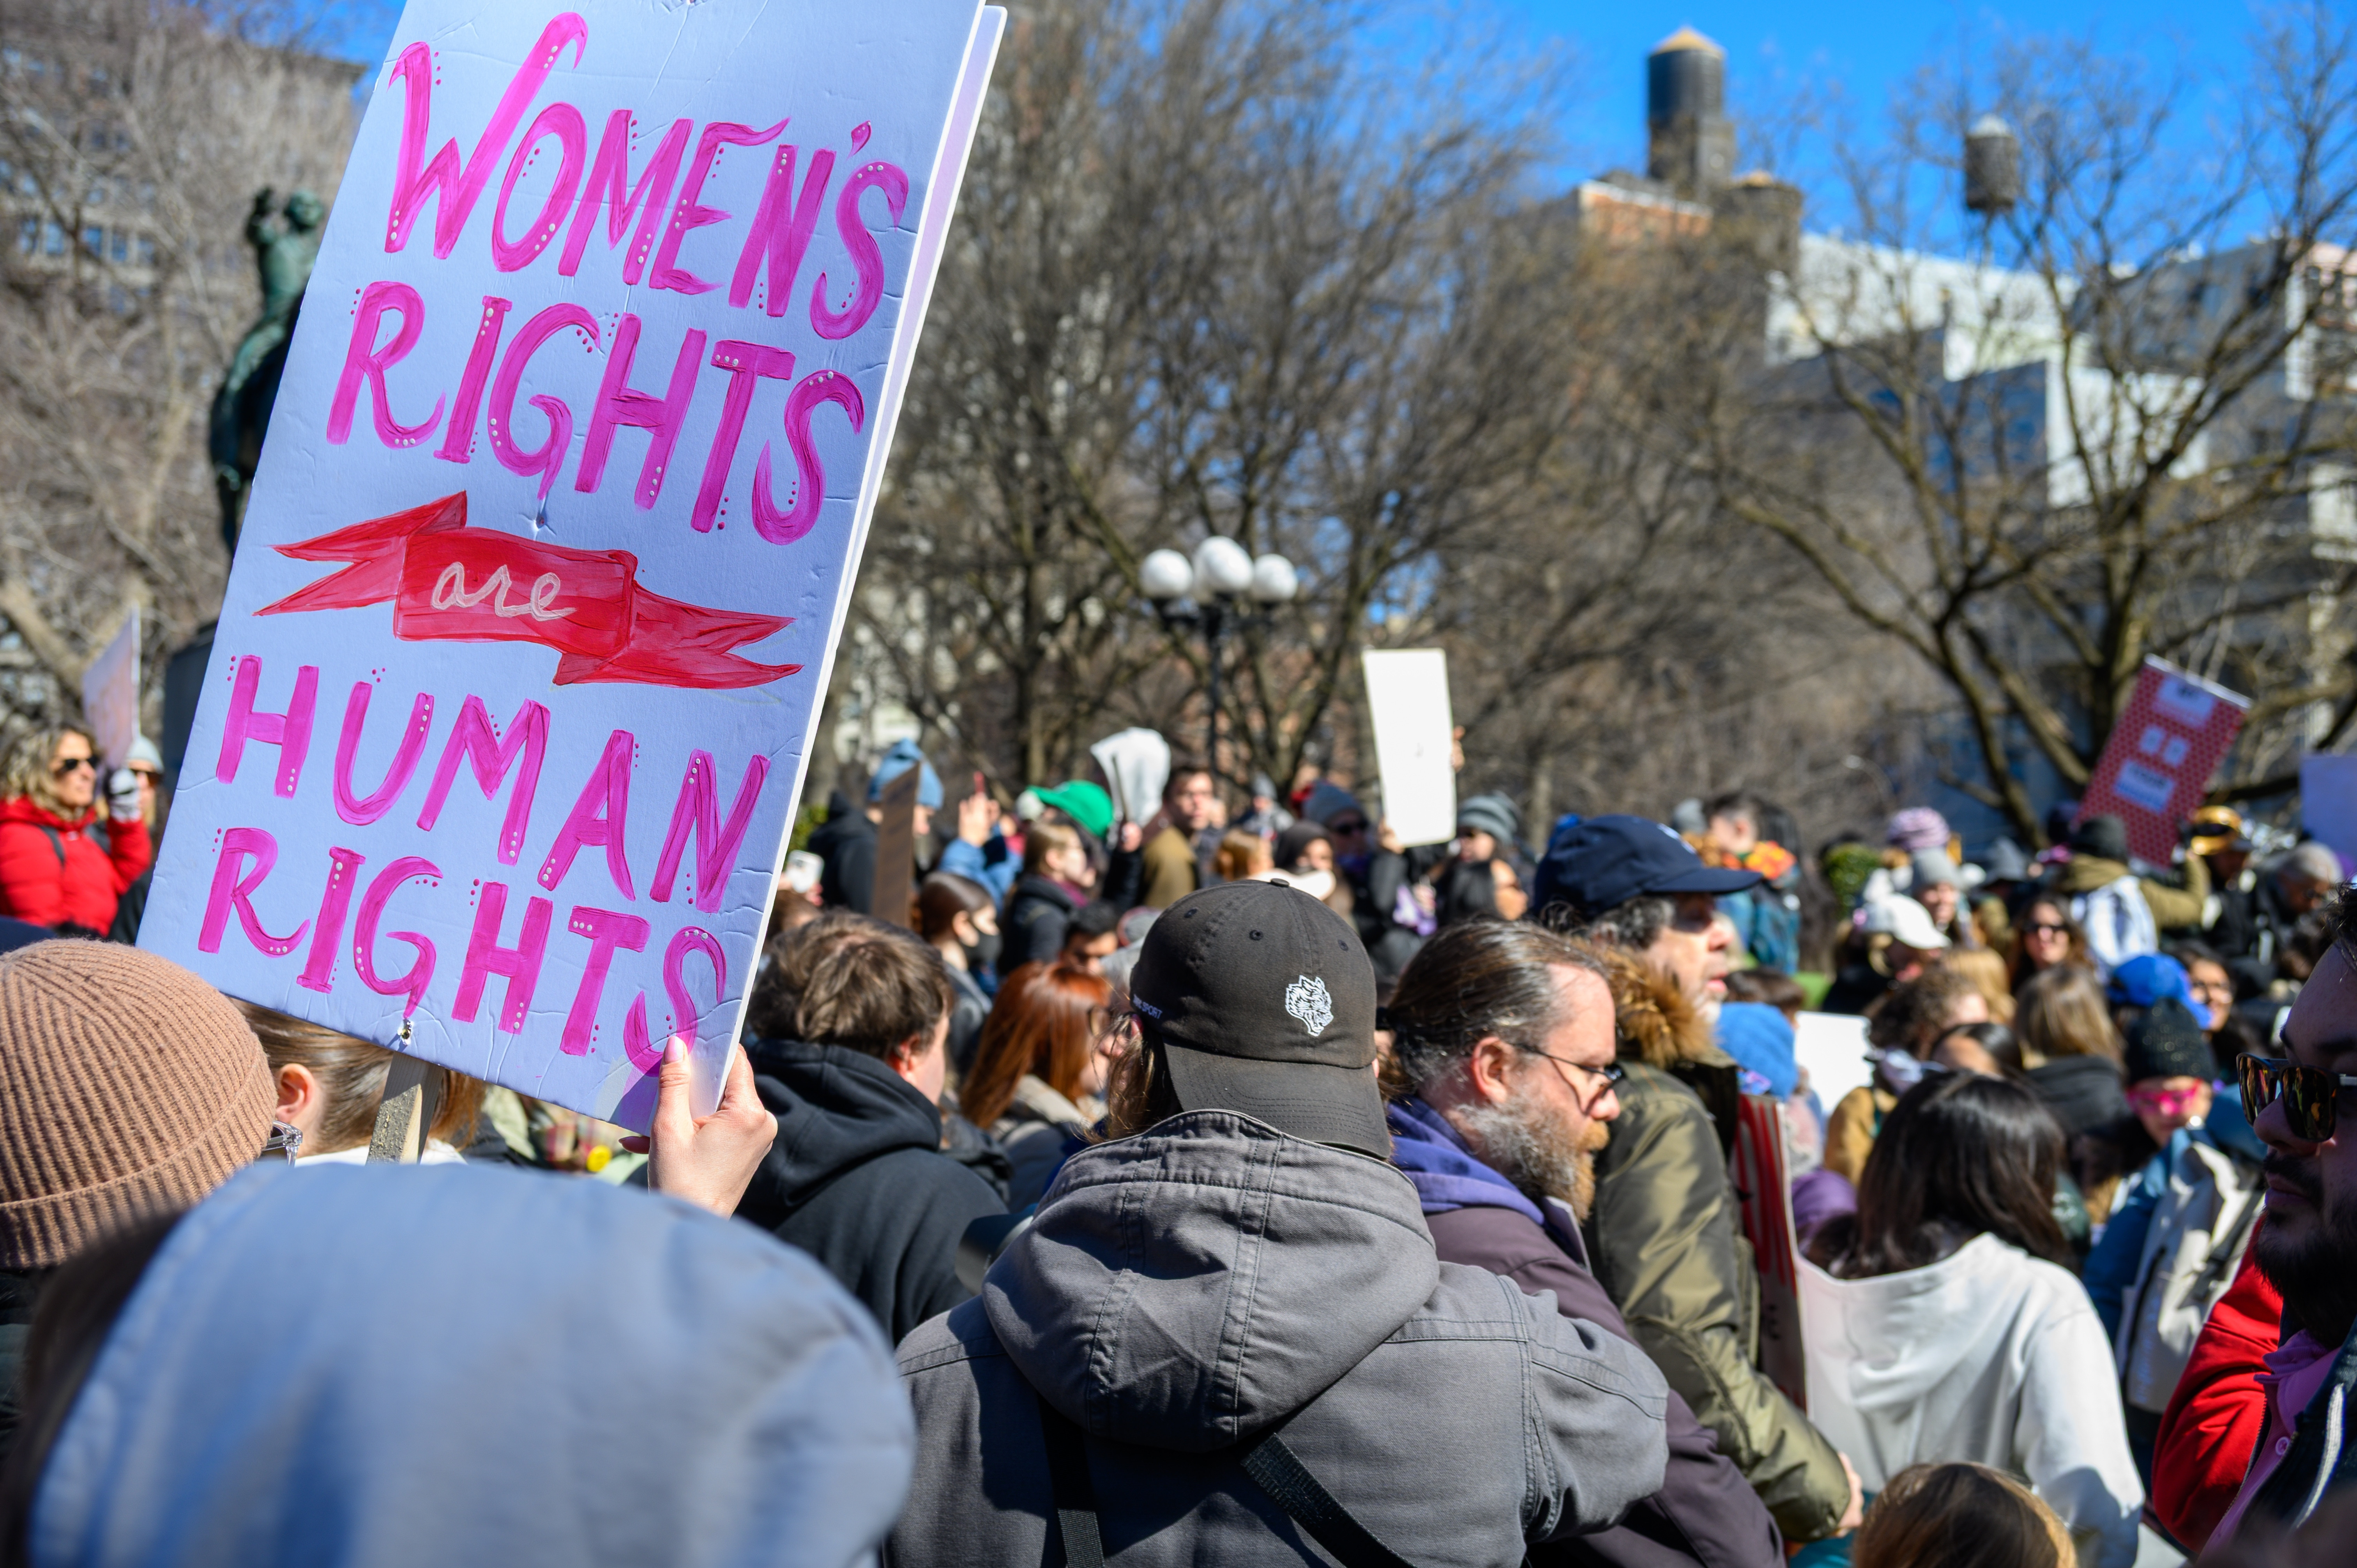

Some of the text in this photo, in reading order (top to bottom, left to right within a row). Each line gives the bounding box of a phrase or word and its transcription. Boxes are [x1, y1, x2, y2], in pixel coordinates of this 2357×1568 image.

[385, 11, 910, 341] WOMEN'S
[327, 281, 865, 546] RIGHTS
[430, 562, 576, 620] are
[216, 654, 771, 914] HUMAN
[198, 826, 727, 1078] RIGHTS
